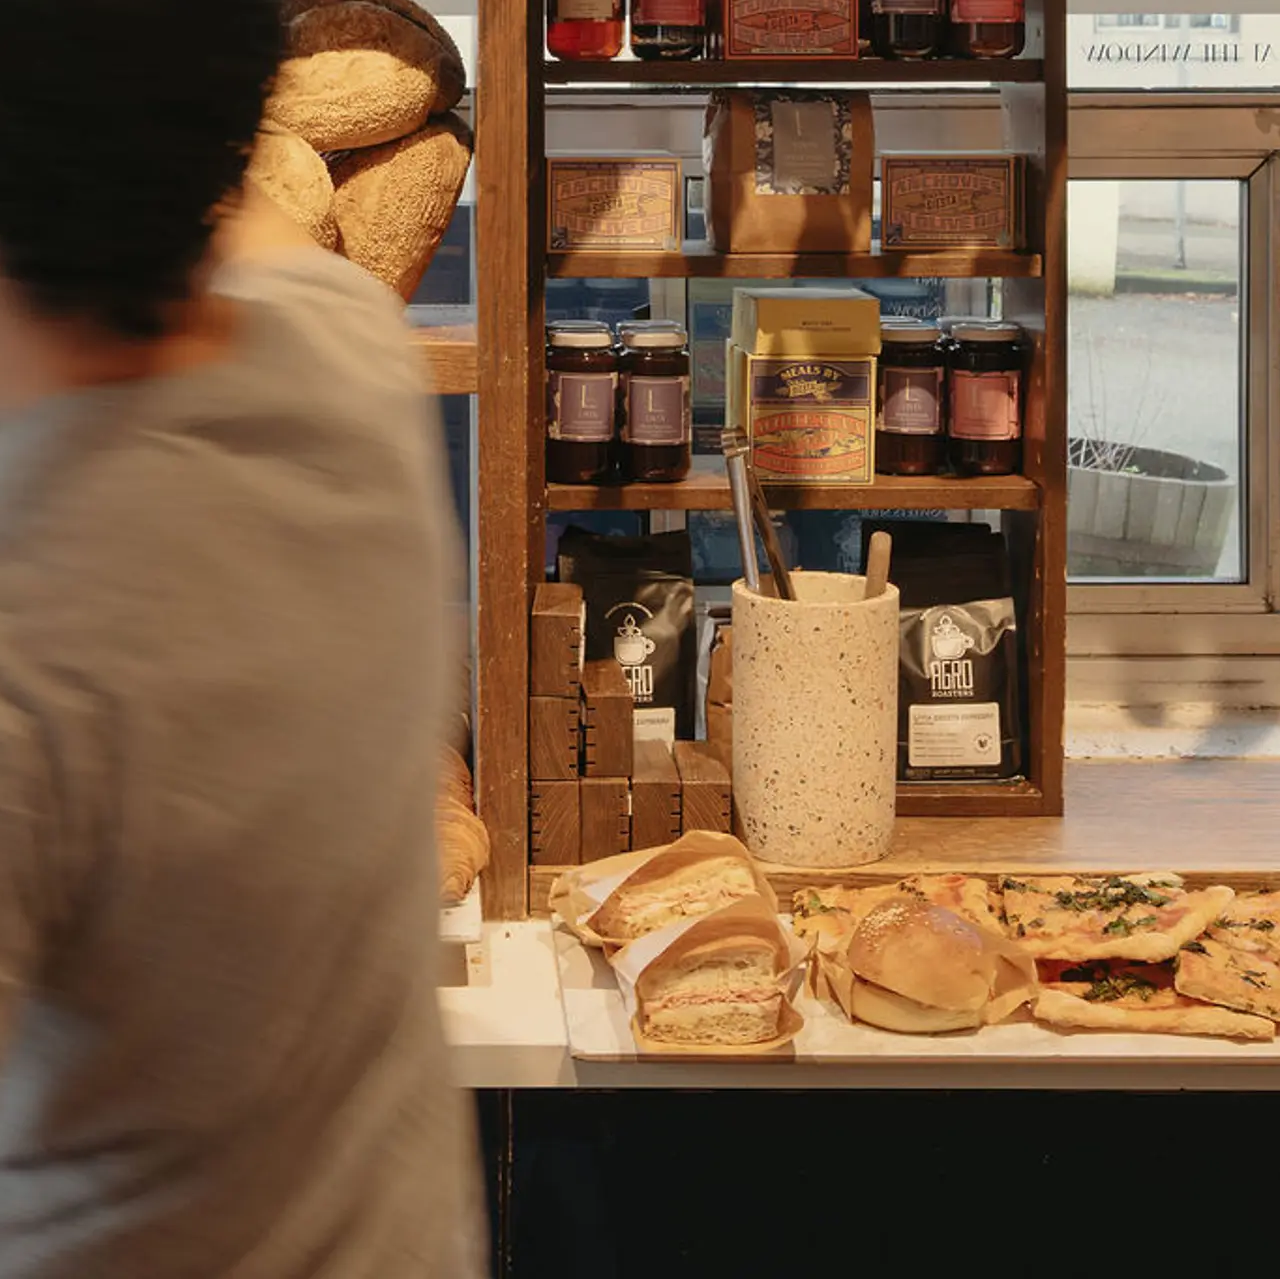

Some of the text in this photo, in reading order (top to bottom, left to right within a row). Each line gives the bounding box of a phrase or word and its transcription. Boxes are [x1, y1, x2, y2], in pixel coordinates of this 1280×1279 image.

[780, 365, 821, 380] MEALS
[621, 665, 654, 696] GRO
[930, 659, 974, 690] AGRO
